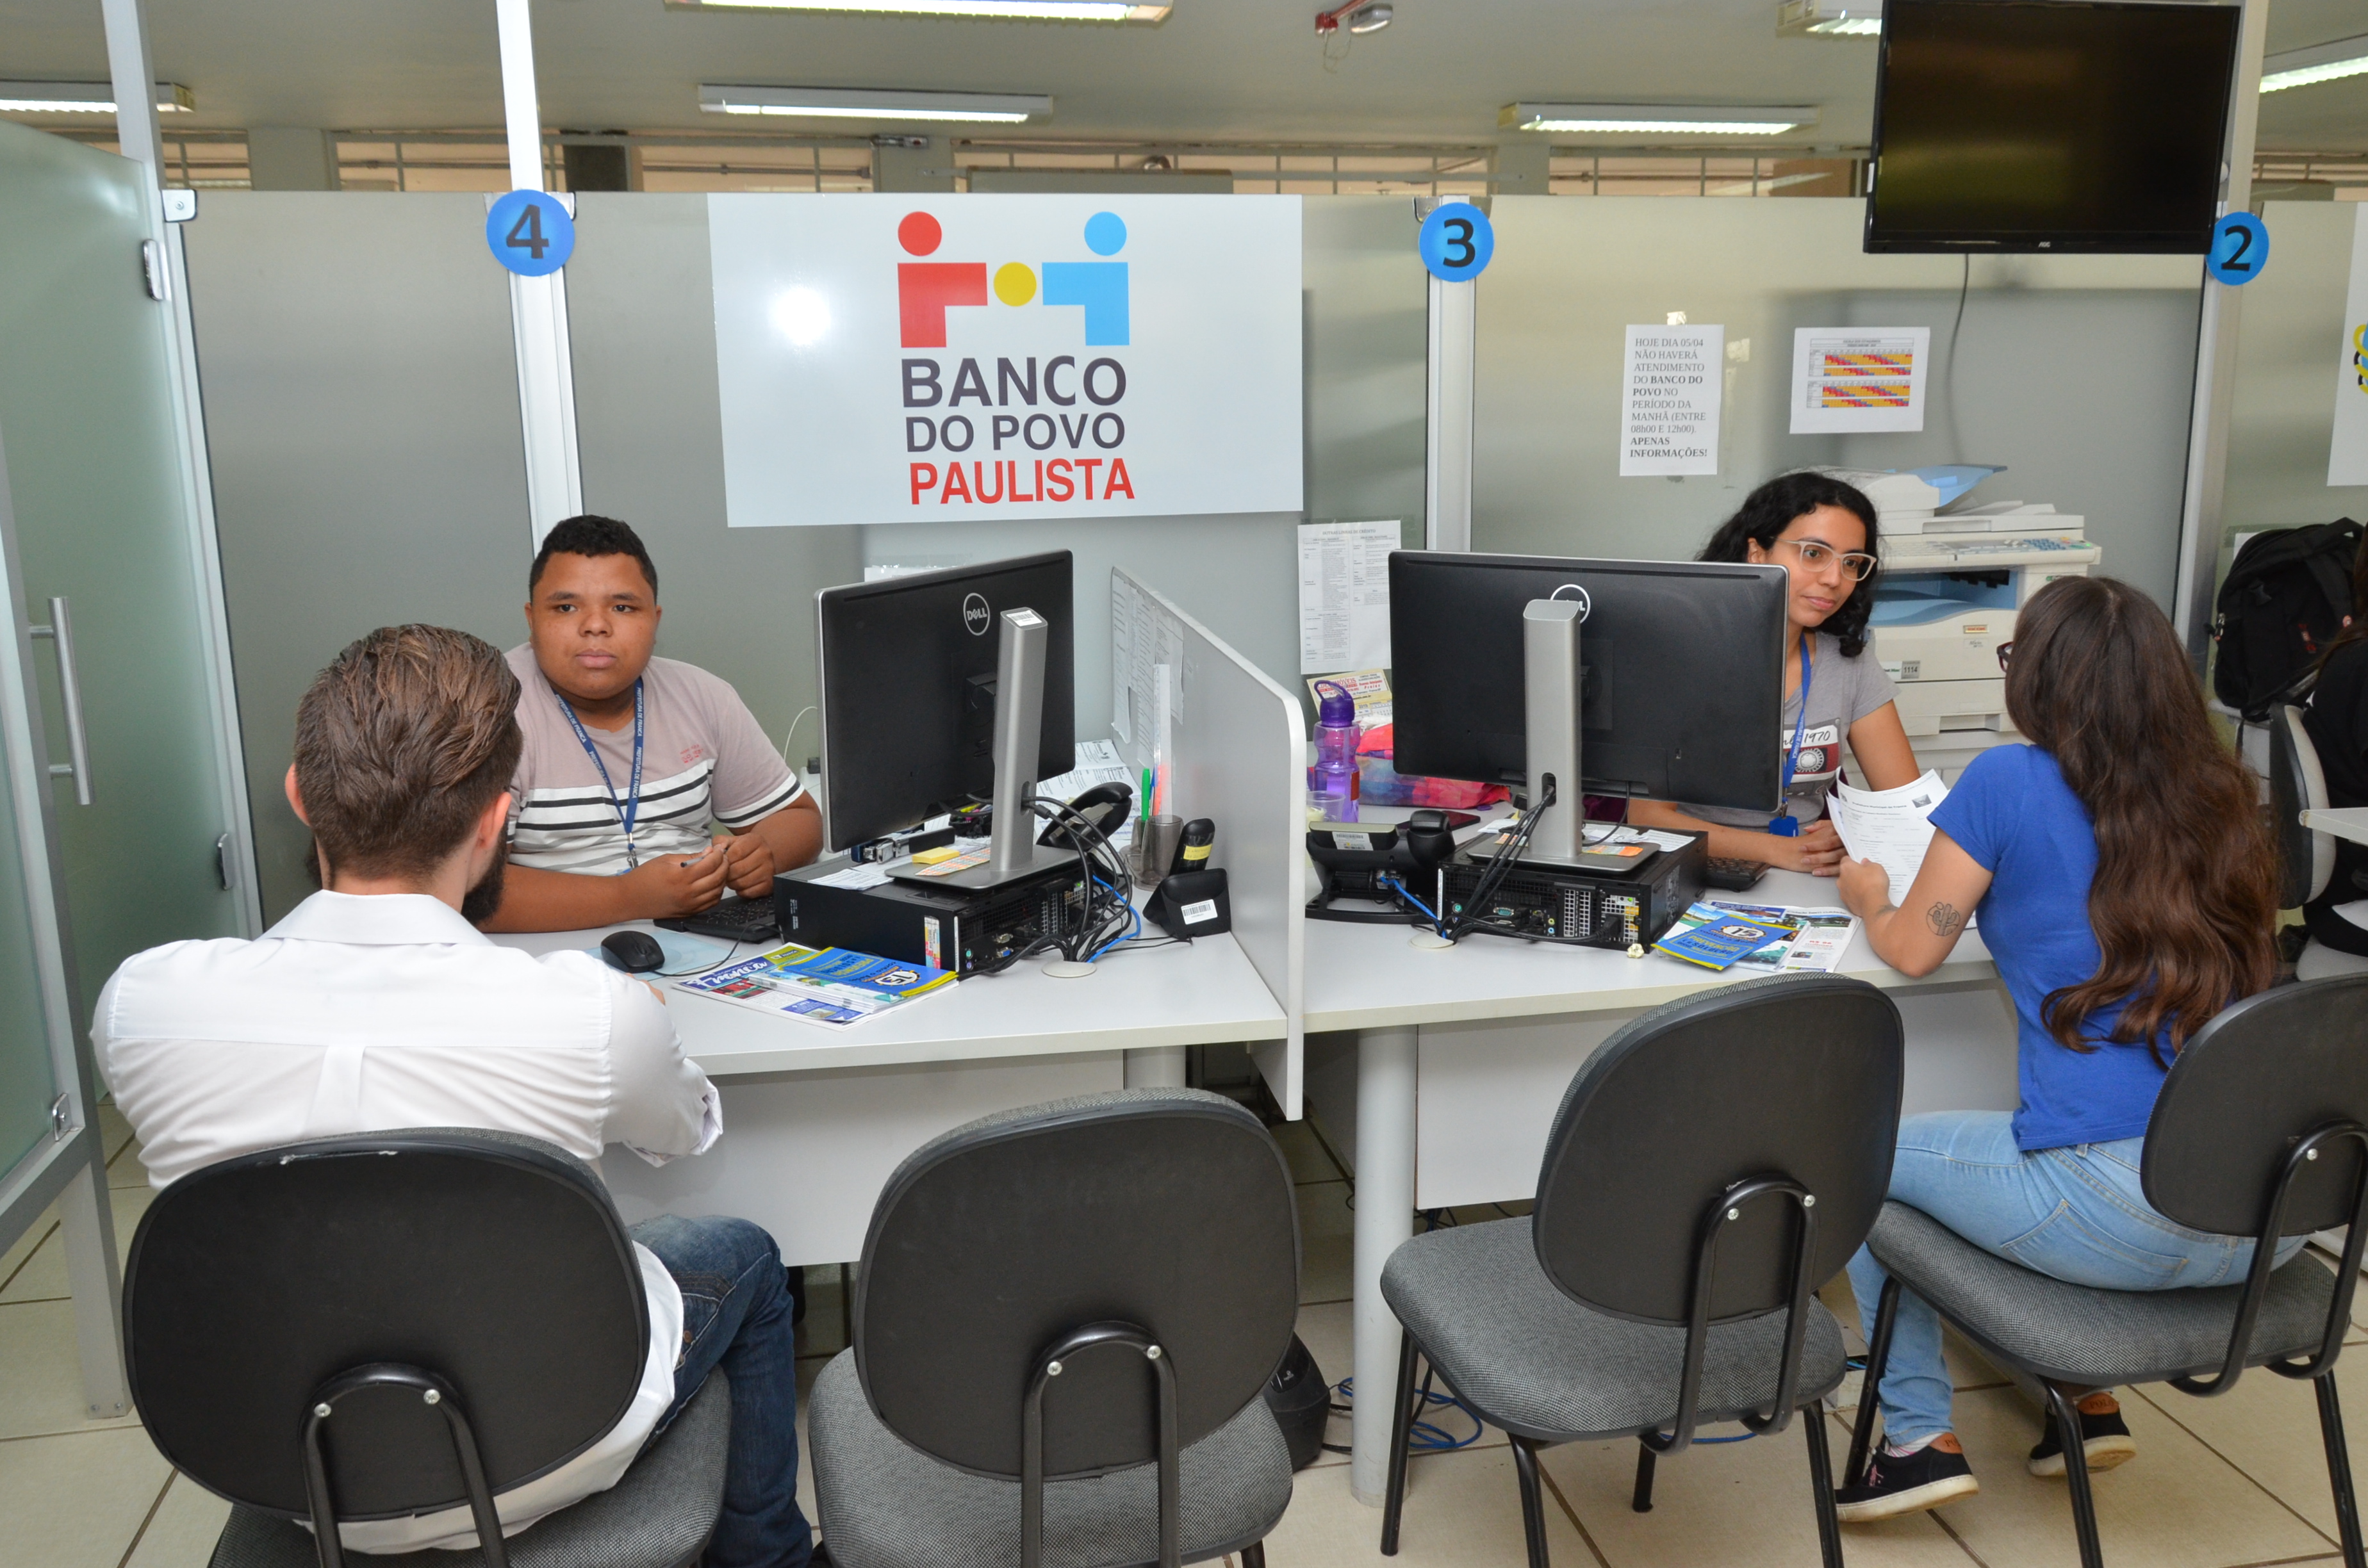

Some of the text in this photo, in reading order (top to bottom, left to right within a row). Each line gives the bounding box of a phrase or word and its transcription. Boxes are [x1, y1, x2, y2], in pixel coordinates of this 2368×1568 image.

[506, 204, 549, 259] 4
[1443, 218, 1476, 268] 3
[2221, 225, 2253, 272] 2
[1635, 338, 1704, 347] HOJE DIA 05/04
[1634, 348, 1698, 359] NÃO HAVERÁ
[1634, 363, 1705, 372] ATENDIMENTO
[901, 355, 1126, 407] BANCO
[1633, 375, 1703, 384] DO BANCO DO
[1632, 388, 1679, 396] POVO NO
[1632, 398, 1691, 409] PERÍODO DA
[1632, 411, 1706, 422] MANHÃ (ENTRE
[905, 412, 1125, 452] DO POVO
[1631, 425, 1697, 435] 08h00 E 12h00).
[1630, 437, 1670, 445] APENAS
[1630, 447, 1707, 459] INFORMAÇÕES!
[910, 457, 1135, 505] PAULISTA
[966, 608, 987, 621] DELL
[555, 694, 573, 719] PREFEITURA
[1804, 730, 1830, 743] 1970
